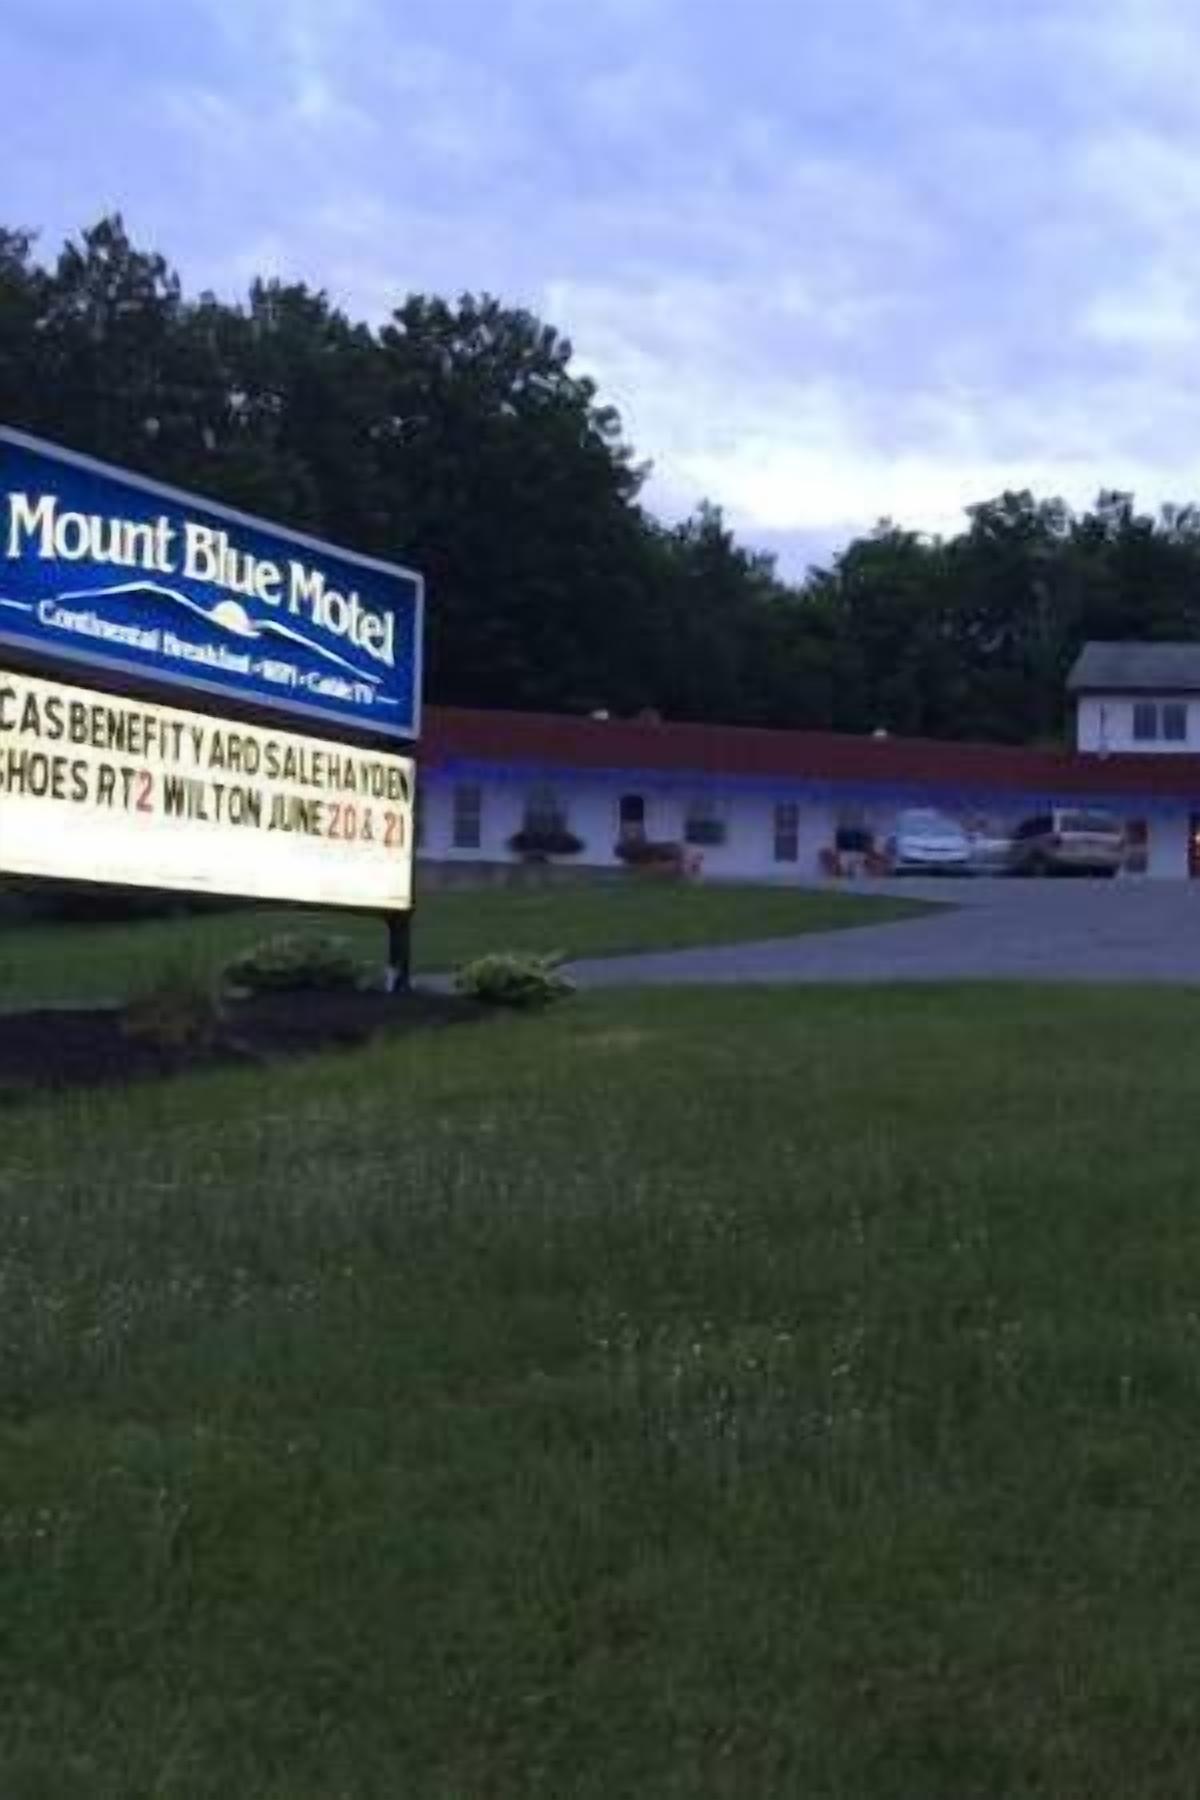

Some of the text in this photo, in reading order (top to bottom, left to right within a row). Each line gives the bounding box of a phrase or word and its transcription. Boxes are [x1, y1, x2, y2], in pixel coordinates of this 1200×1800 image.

[7, 491, 395, 668] Mount Blue Motel
[0, 748, 88, 803] HOES
[163, 773, 262, 829] WILTON
[268, 792, 323, 837] JUNE
[327, 802, 358, 842] 20
[383, 810, 406, 848] 21
[69, 701, 184, 762] BENEFIT
[190, 725, 260, 776] YARD
[264, 740, 323, 787] SALE
[328, 753, 410, 804] HAYDEN
